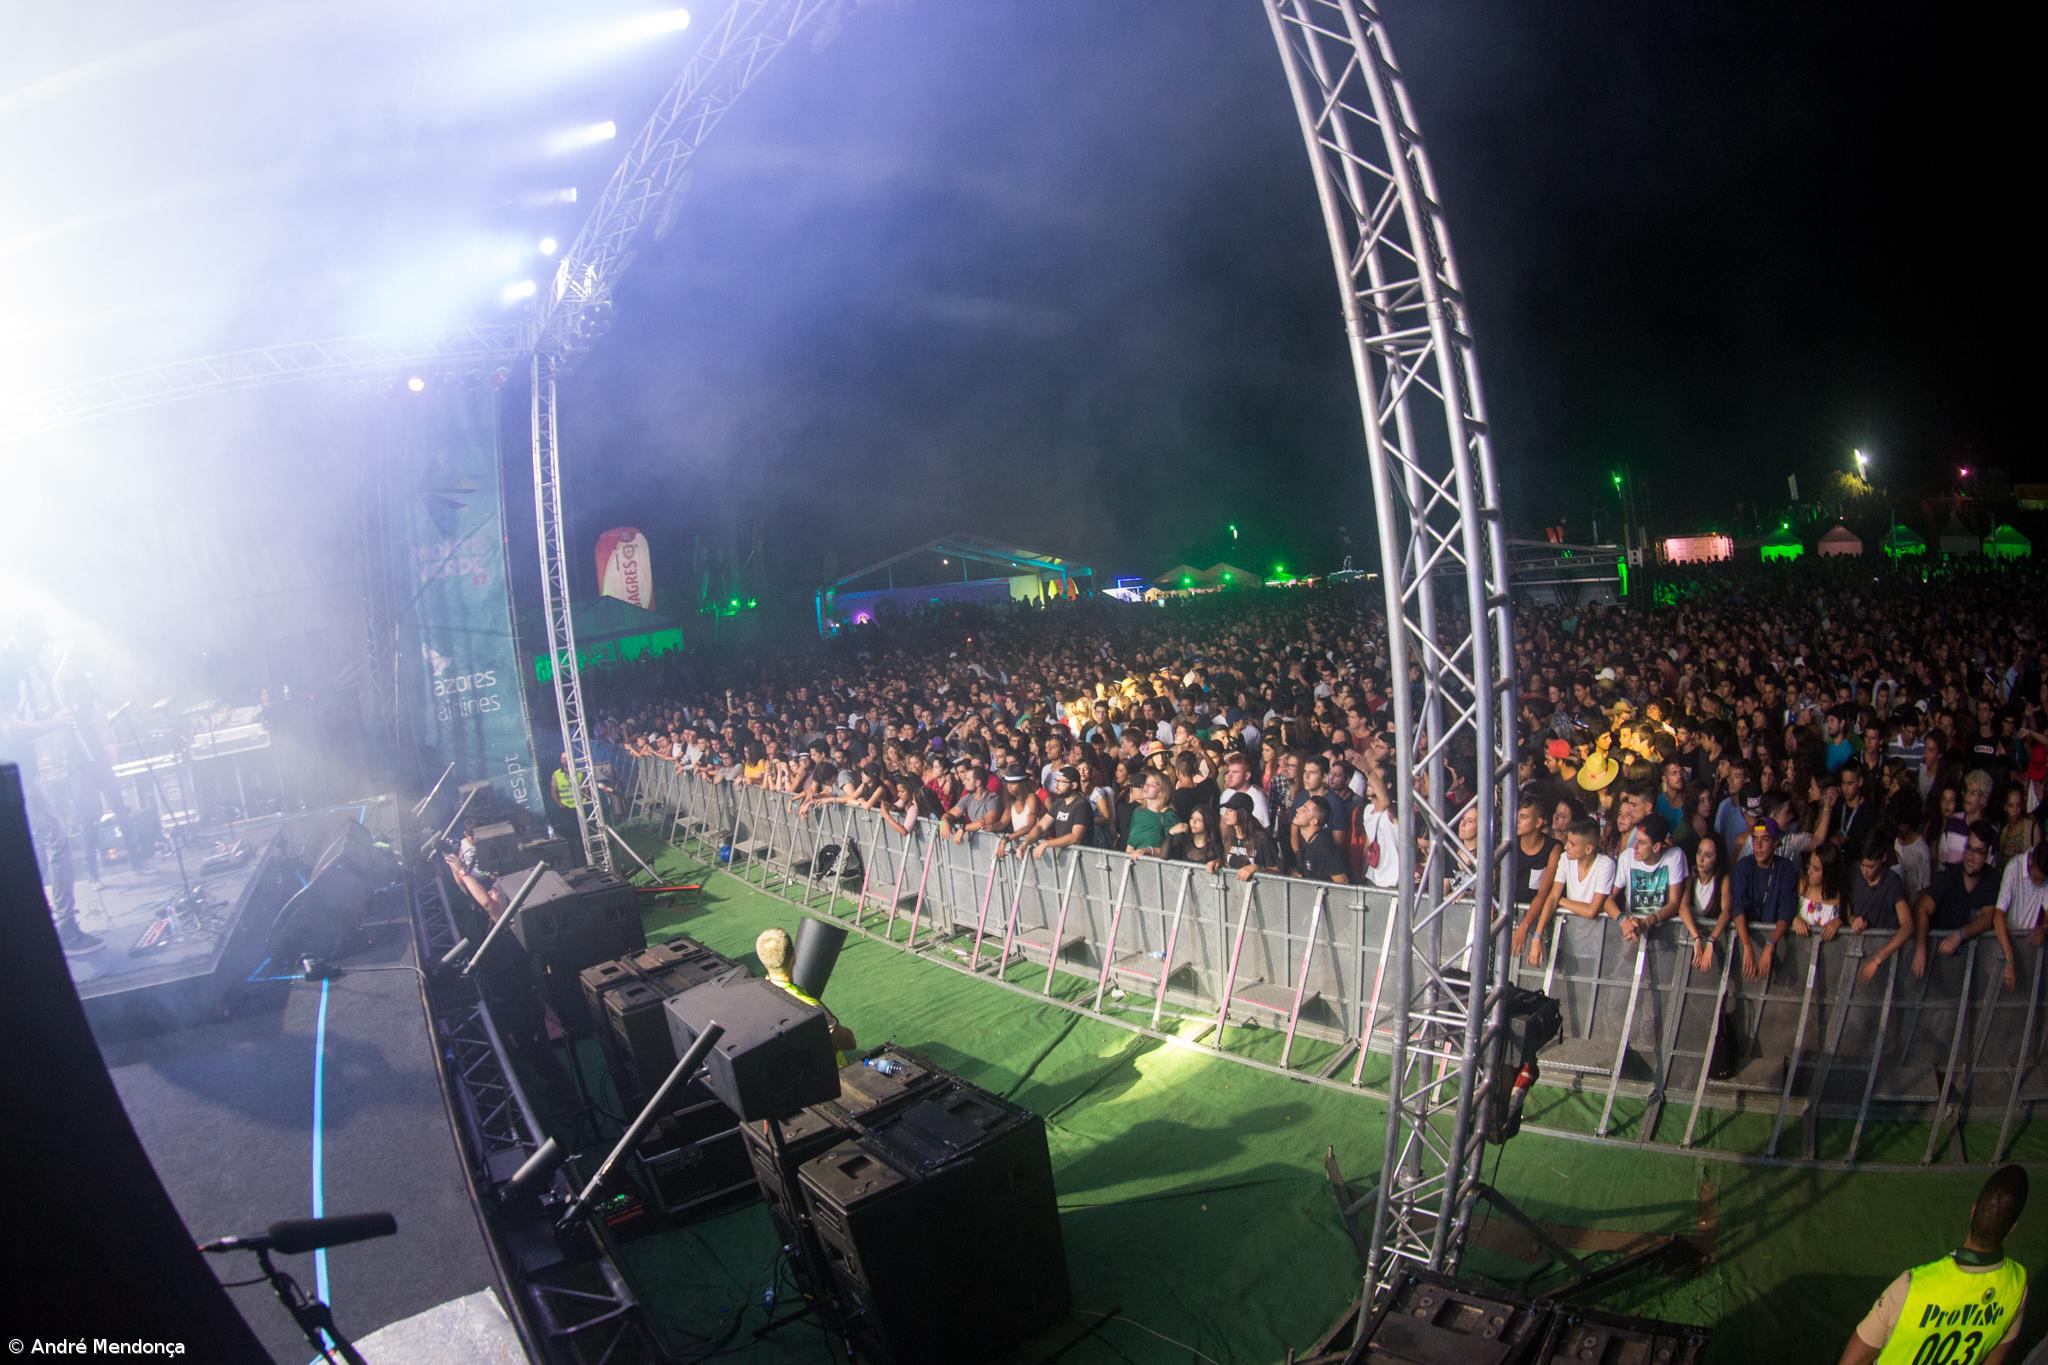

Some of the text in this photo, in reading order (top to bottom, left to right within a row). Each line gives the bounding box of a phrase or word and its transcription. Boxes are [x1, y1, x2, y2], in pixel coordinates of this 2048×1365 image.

[433, 669, 497, 697] azores
[438, 694, 501, 721] airlines
[1911, 1330, 1984, 1365] 003
